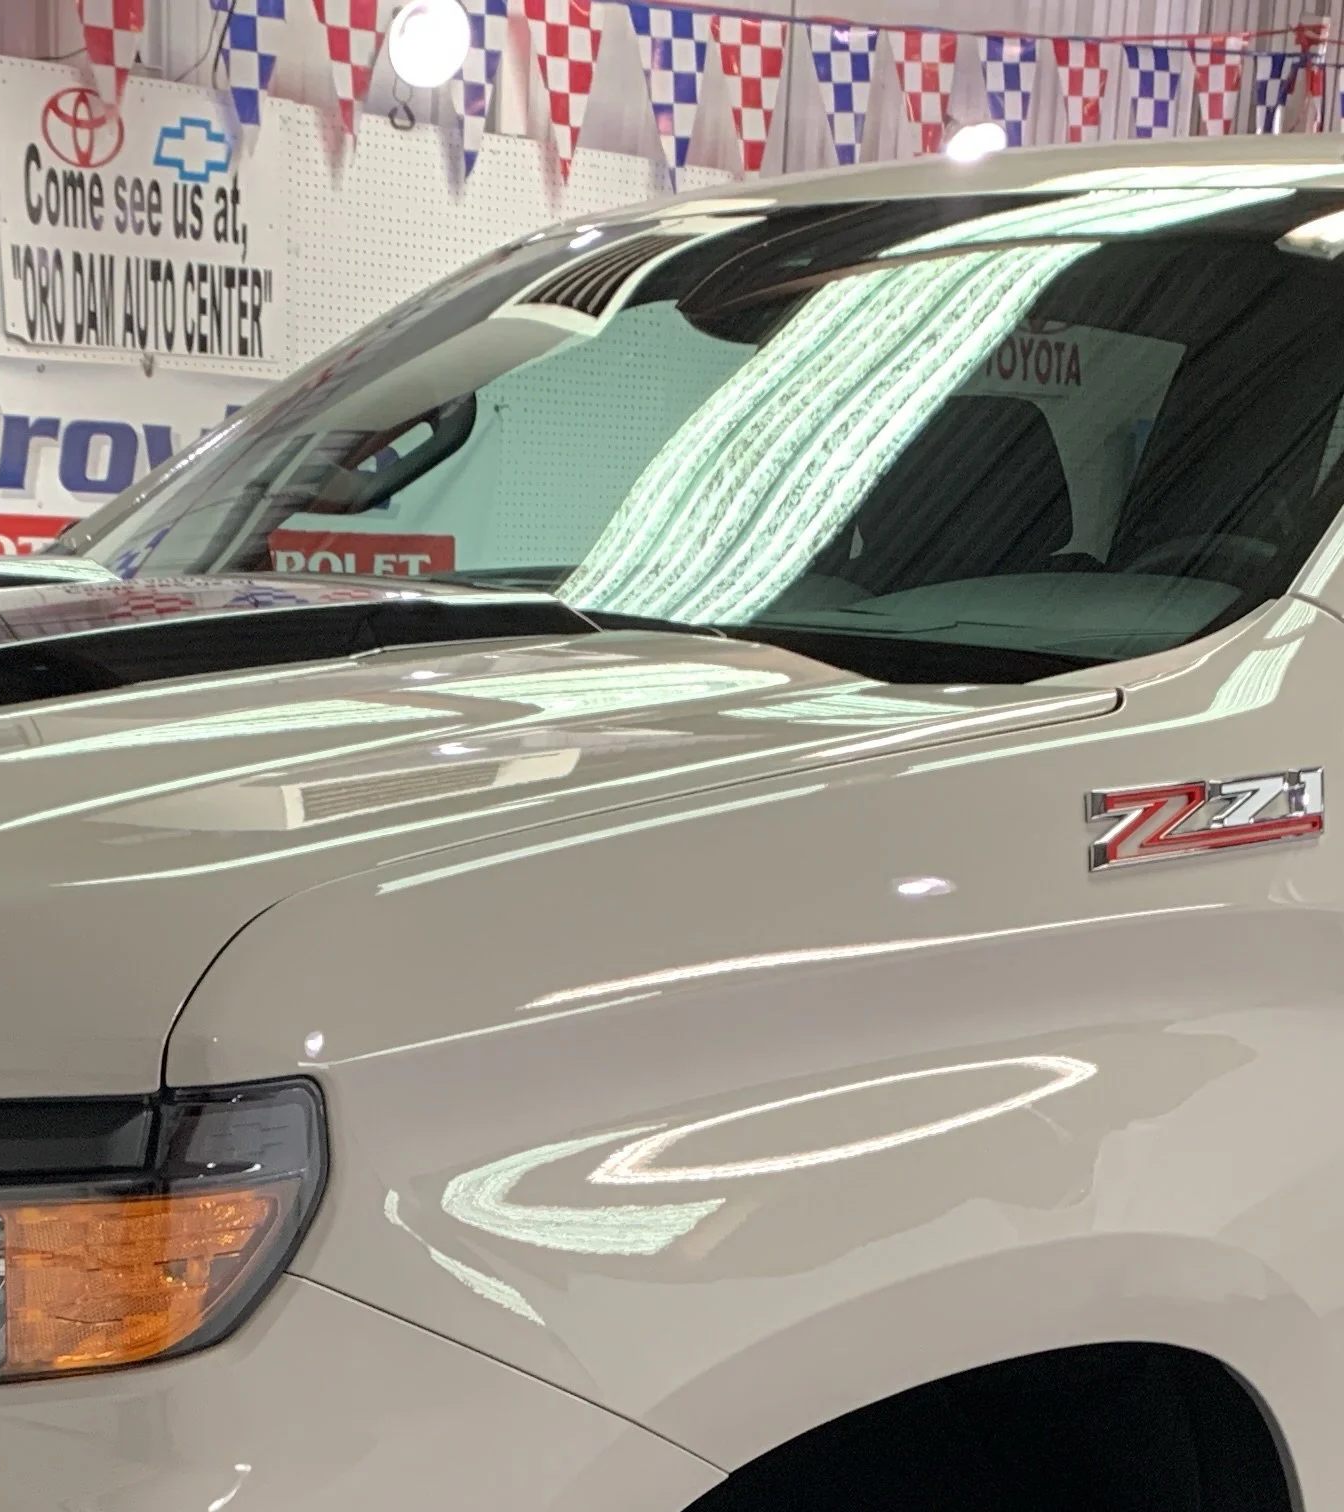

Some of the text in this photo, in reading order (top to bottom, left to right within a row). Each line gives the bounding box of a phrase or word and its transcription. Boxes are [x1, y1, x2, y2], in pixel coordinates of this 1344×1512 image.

[24, 142, 104, 231] Come
[114, 176, 162, 237] see
[173, 182, 203, 241] us
[11, 244, 272, 358] "ORO DAM AUTO CENTER"
[1085, 766, 1324, 872] Z71
